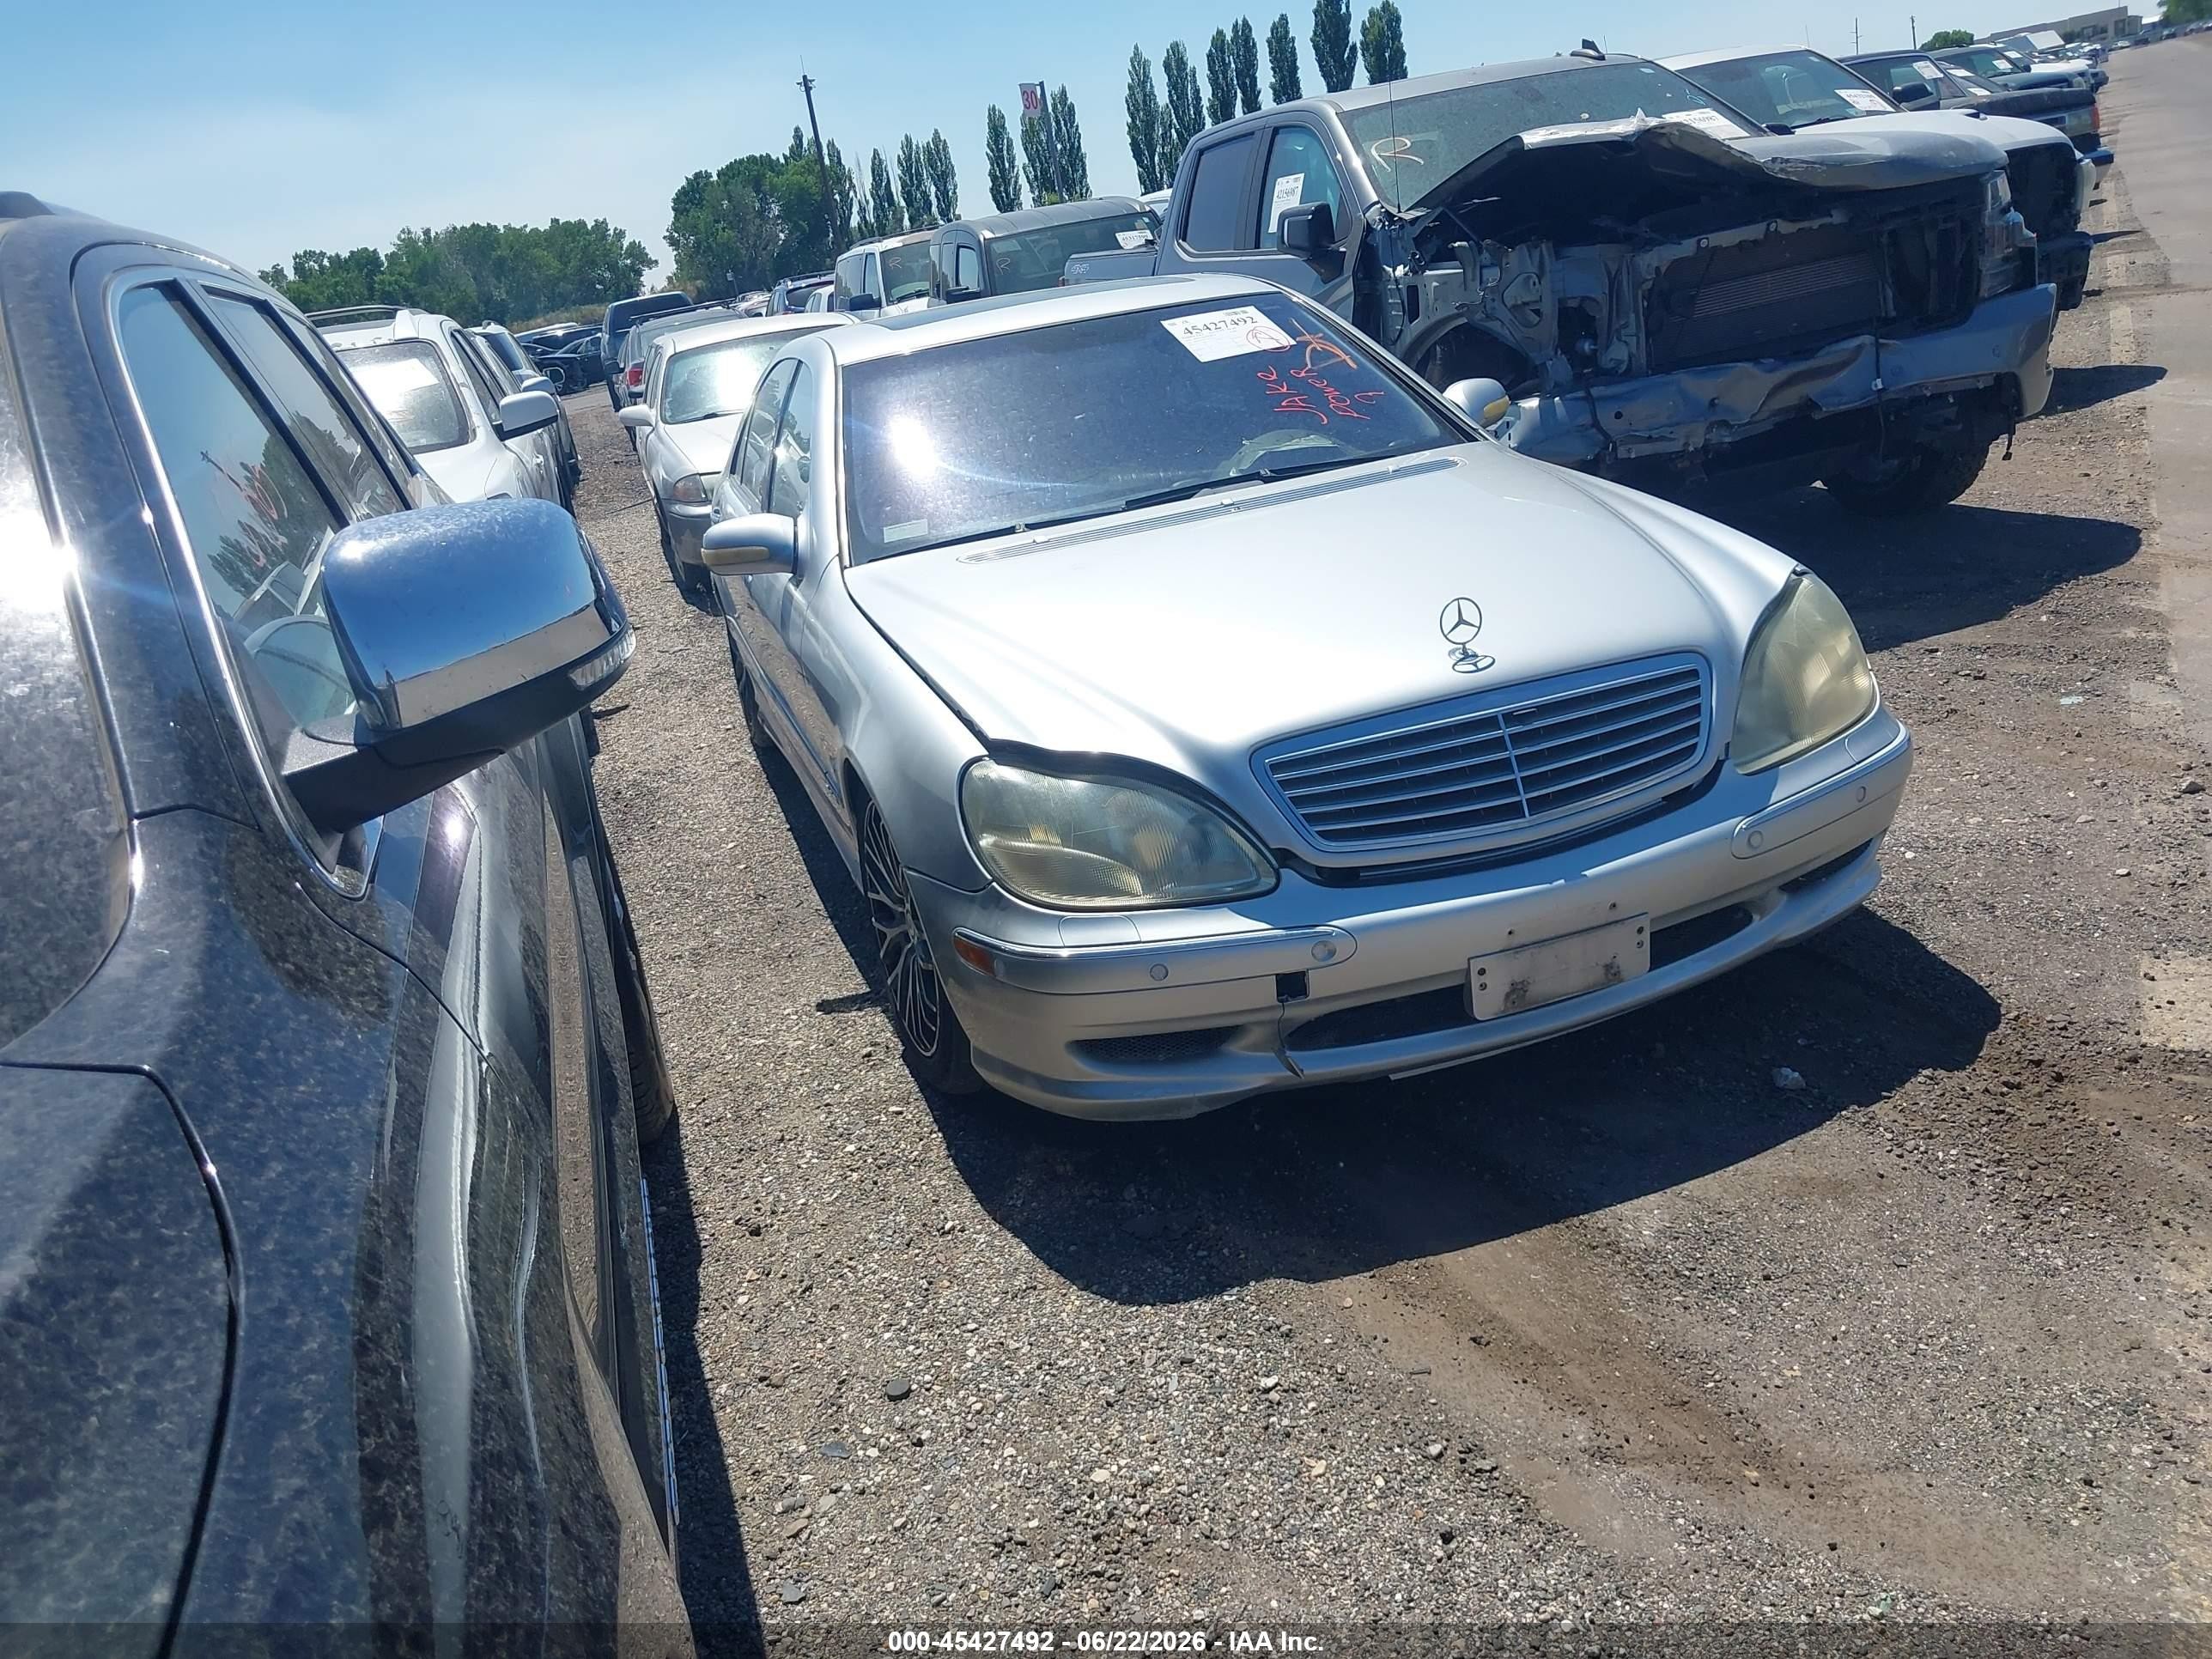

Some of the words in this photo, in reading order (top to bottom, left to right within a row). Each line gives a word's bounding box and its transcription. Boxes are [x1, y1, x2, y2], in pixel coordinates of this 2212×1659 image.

[1022, 89, 1038, 110] 30
[1370, 137, 1425, 173] R
[1183, 315, 1259, 337] 45427492
